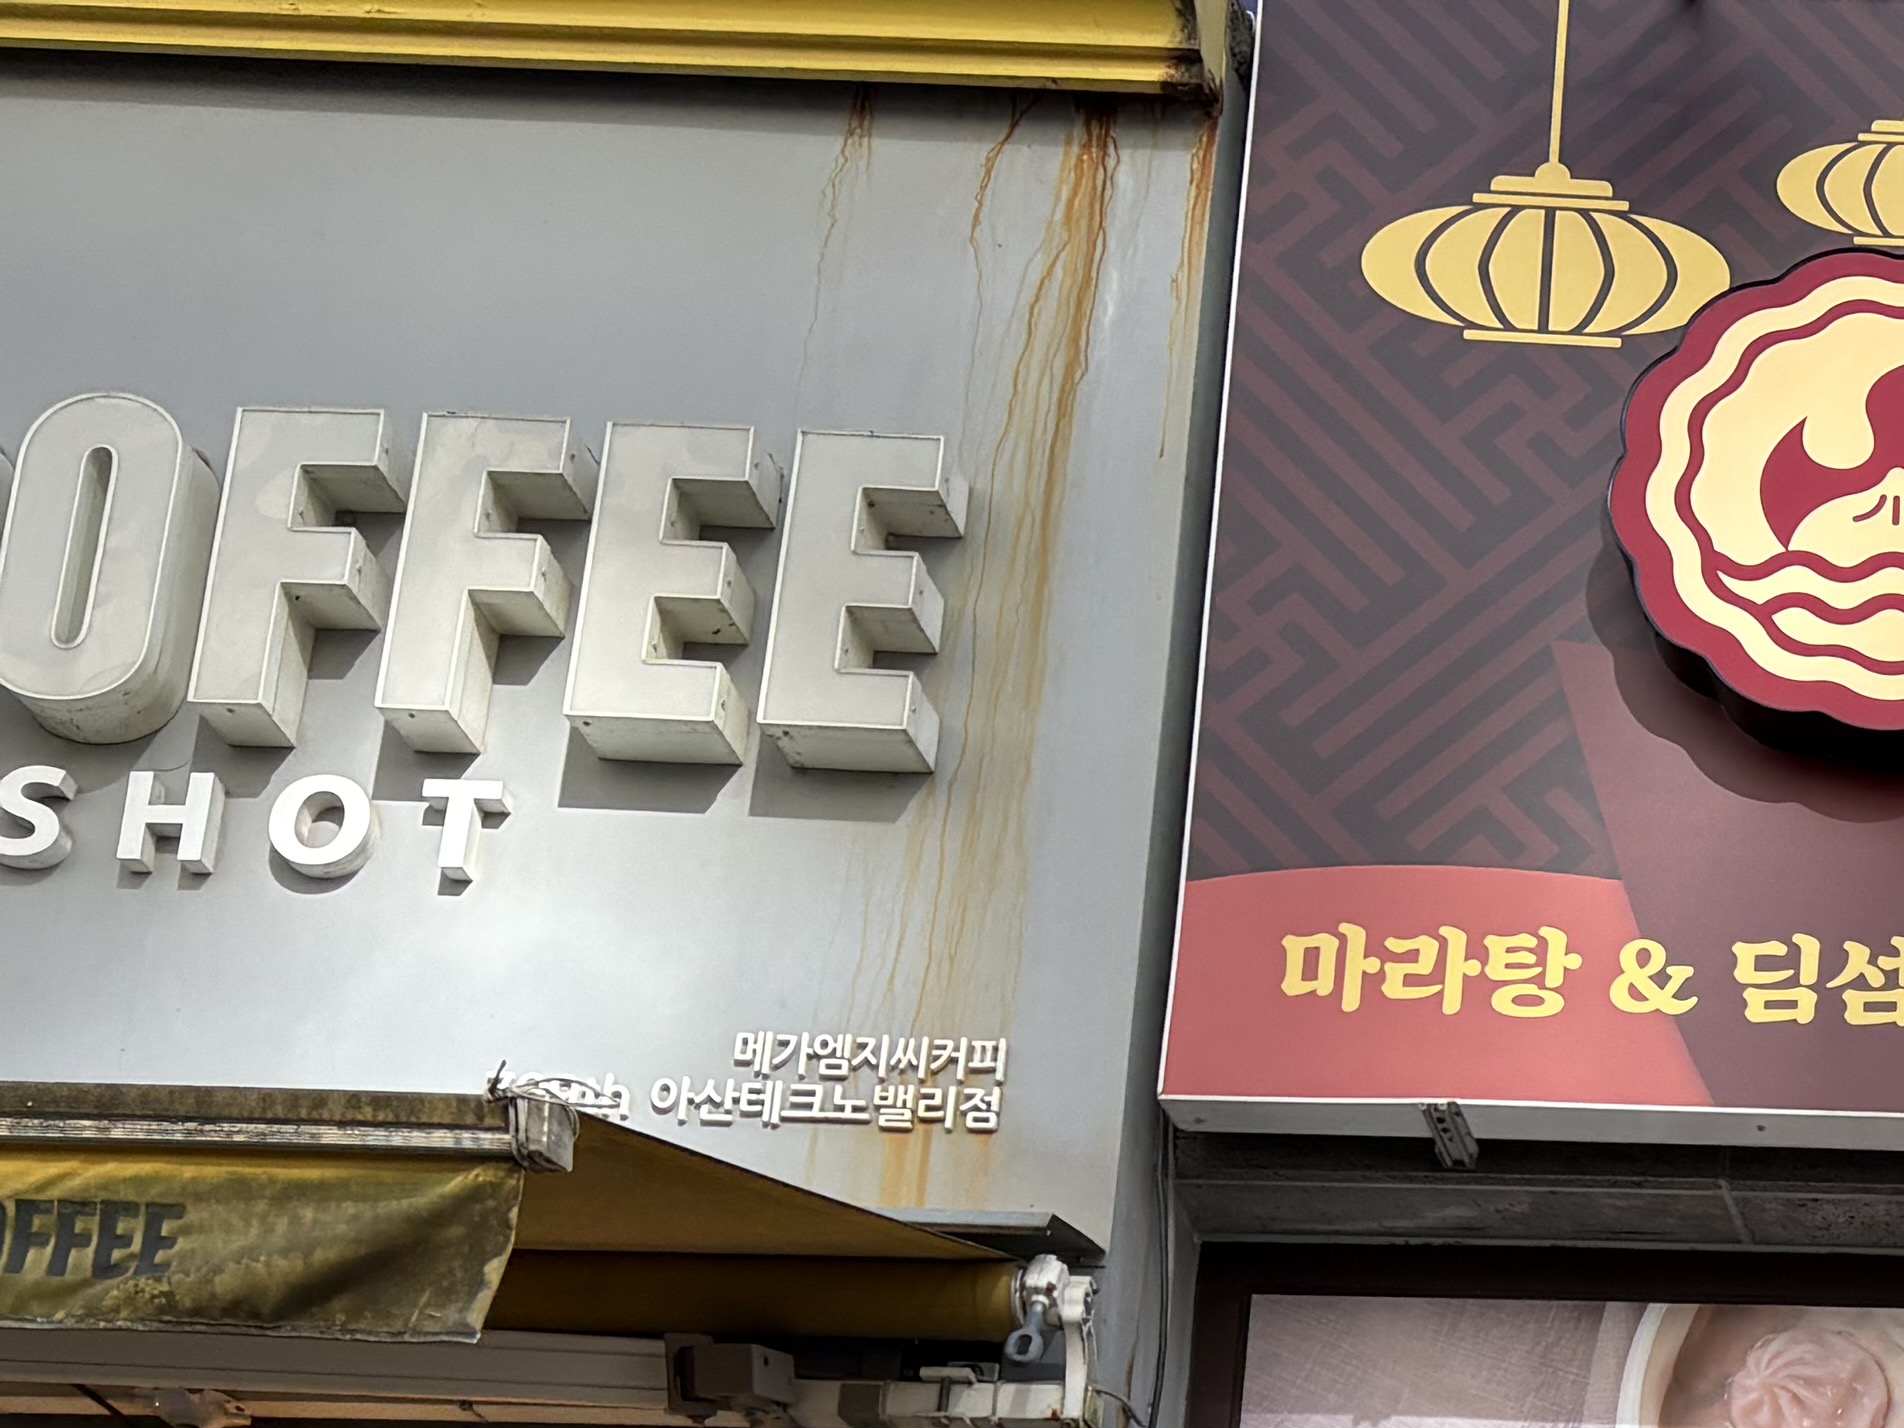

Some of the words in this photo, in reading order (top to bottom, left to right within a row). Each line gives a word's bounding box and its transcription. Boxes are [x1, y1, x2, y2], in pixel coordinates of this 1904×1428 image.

[0, 392, 966, 770] OFFEE
[0, 764, 511, 881] SHOT
[1279, 922, 1582, 1019] 마라탕
[1609, 938, 1698, 1014] &
[733, 1030, 1007, 1082] 메가엠지씨커피
[650, 1077, 1003, 1132] 아산테크노밸리점
[0, 1199, 187, 1281] FFEE
